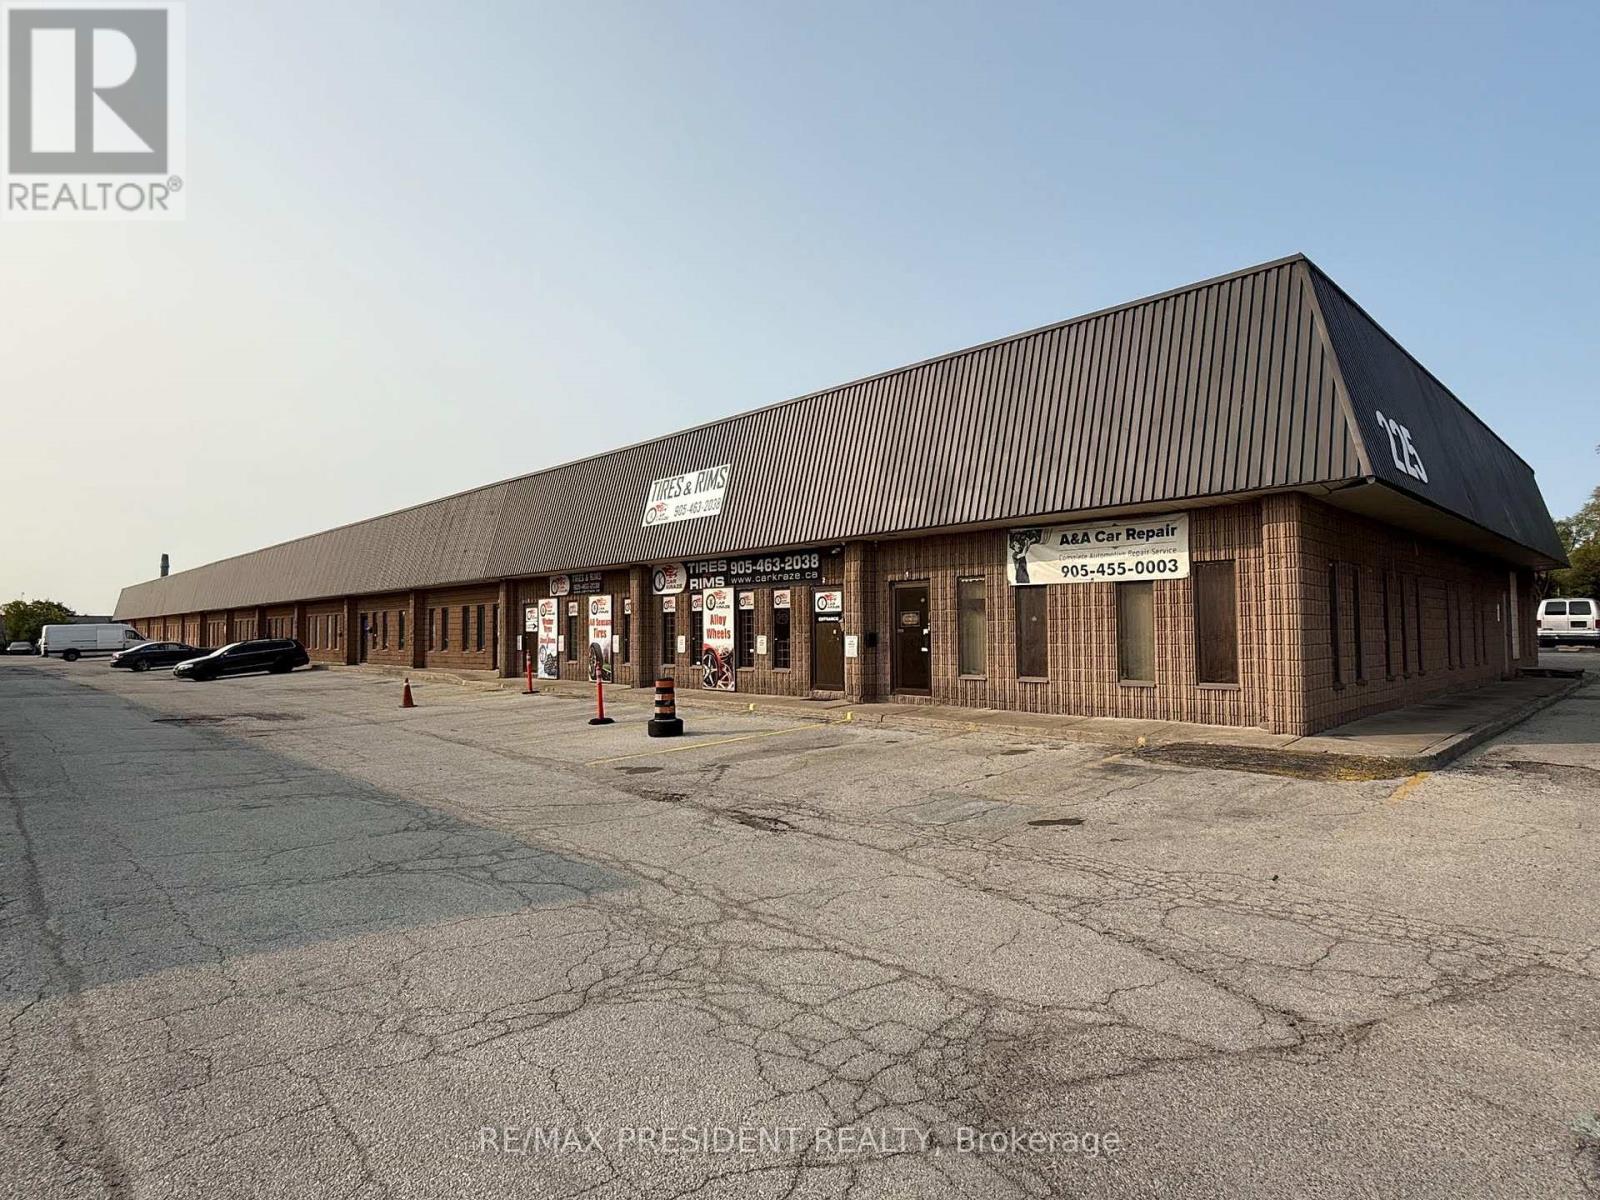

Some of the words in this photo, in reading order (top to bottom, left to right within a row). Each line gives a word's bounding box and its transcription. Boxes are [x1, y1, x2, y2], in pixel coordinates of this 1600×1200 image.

[1376, 410, 1428, 484] 225
[652, 476, 684, 502] TIRES
[684, 481, 692, 496] &
[694, 466, 728, 494] RIMS
[674, 498, 721, 517] 905-463-2038
[1060, 531, 1091, 546] A&A
[1095, 530, 1122, 543] Car
[1126, 524, 1177, 542] Repair
[1128, 548, 1149, 557] Repair
[687, 560, 727, 574] TIRES
[730, 554, 819, 575] 905-463-2038
[1061, 559, 1178, 578] 905-455-0003
[690, 576, 725, 590] RIMS
[731, 570, 818, 584] www.carkraze.ca
[709, 614, 726, 627] Alloy
[594, 628, 607, 638] Tires
[706, 628, 730, 640] Wheels
